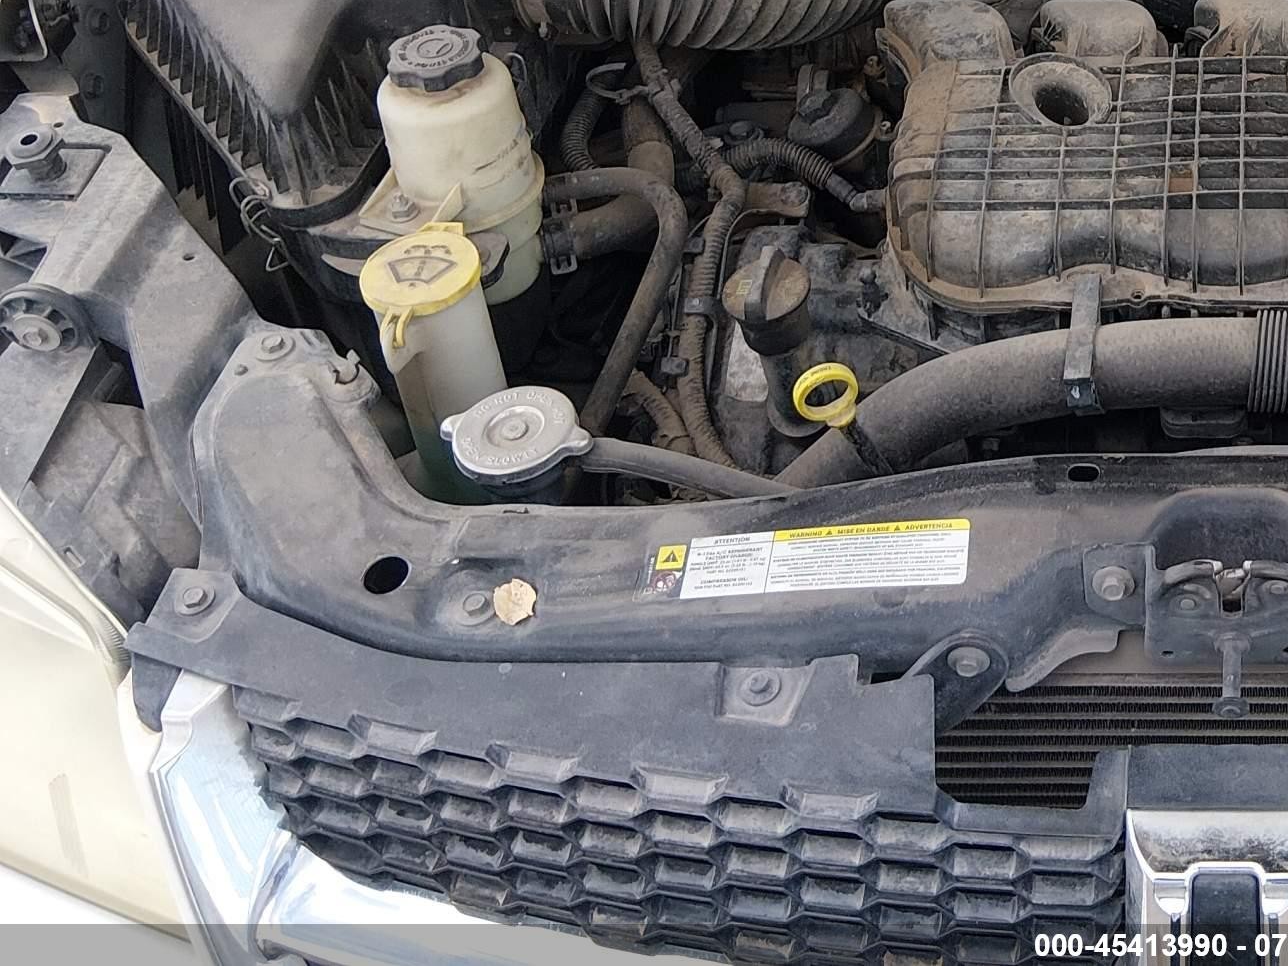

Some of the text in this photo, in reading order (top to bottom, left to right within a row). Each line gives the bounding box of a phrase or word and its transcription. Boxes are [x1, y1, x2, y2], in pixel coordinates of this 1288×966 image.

[494, 392, 521, 406] NOT
[527, 390, 554, 407] OPEN
[789, 531, 823, 539] WARNING
[905, 522, 953, 531] ADVERTENCIA
[714, 536, 751, 545] ATTENTION
